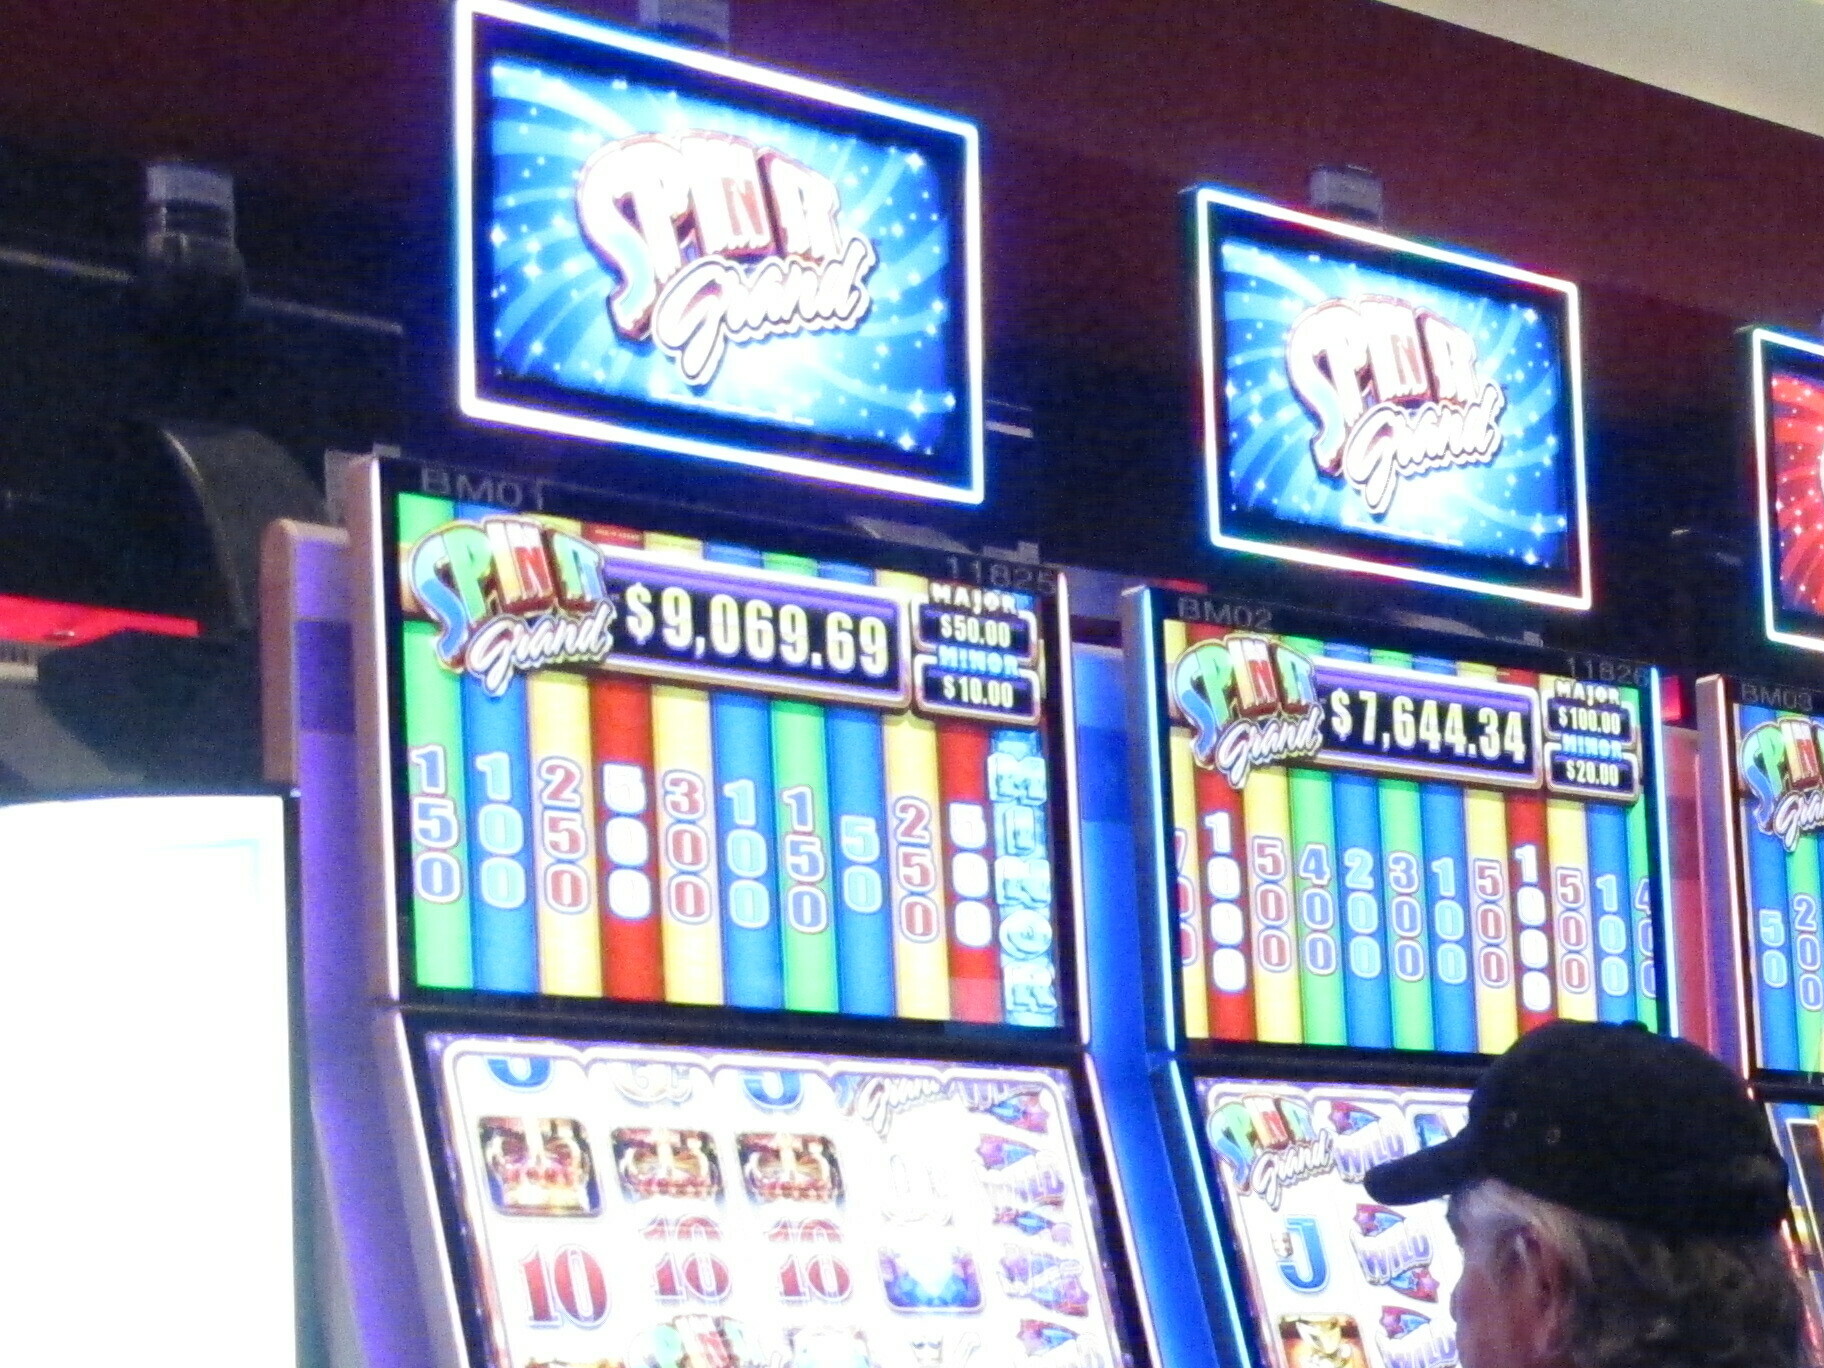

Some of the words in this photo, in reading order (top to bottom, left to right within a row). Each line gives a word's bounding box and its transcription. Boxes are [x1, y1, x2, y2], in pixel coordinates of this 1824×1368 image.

[421, 468, 544, 511] BM01
[410, 515, 556, 672] SPIN
[627, 583, 889, 676] $9,069.69
[930, 583, 1018, 615] MAJOR
[940, 613, 1012, 648] $50.00
[1178, 597, 1273, 631] BM02
[938, 645, 1020, 677] MINOR
[943, 675, 1014, 709] $10.00
[1173, 633, 1276, 770] SPIN
[1555, 679, 1621, 706] MAJOR
[1558, 706, 1621, 735] $100.00
[1332, 688, 1526, 763] $7,644.34
[1562, 733, 1623, 762] MINOR
[1566, 759, 1619, 787] $20.00
[1739, 717, 1816, 836] SPIN
[410, 745, 462, 905] 150
[476, 751, 526, 909] 100
[538, 757, 588, 915] 250
[664, 770, 712, 925] 300
[723, 779, 770, 928] 100
[782, 785, 830, 934] 150
[840, 815, 882, 915] 50
[892, 796, 938, 944] 250
[1252, 835, 1292, 973] 500
[1299, 842, 1337, 976] 400
[1344, 847, 1382, 979] 200
[1388, 851, 1426, 983] 300
[1431, 857, 1468, 985] 100
[1473, 859, 1511, 988] 500
[1556, 867, 1592, 994] 500
[1596, 874, 1630, 998] 100
[1758, 909, 1788, 989] 50
[1793, 893, 1824, 1012] 200
[518, 1243, 612, 1330] 10
[1278, 1214, 1331, 1294] J
